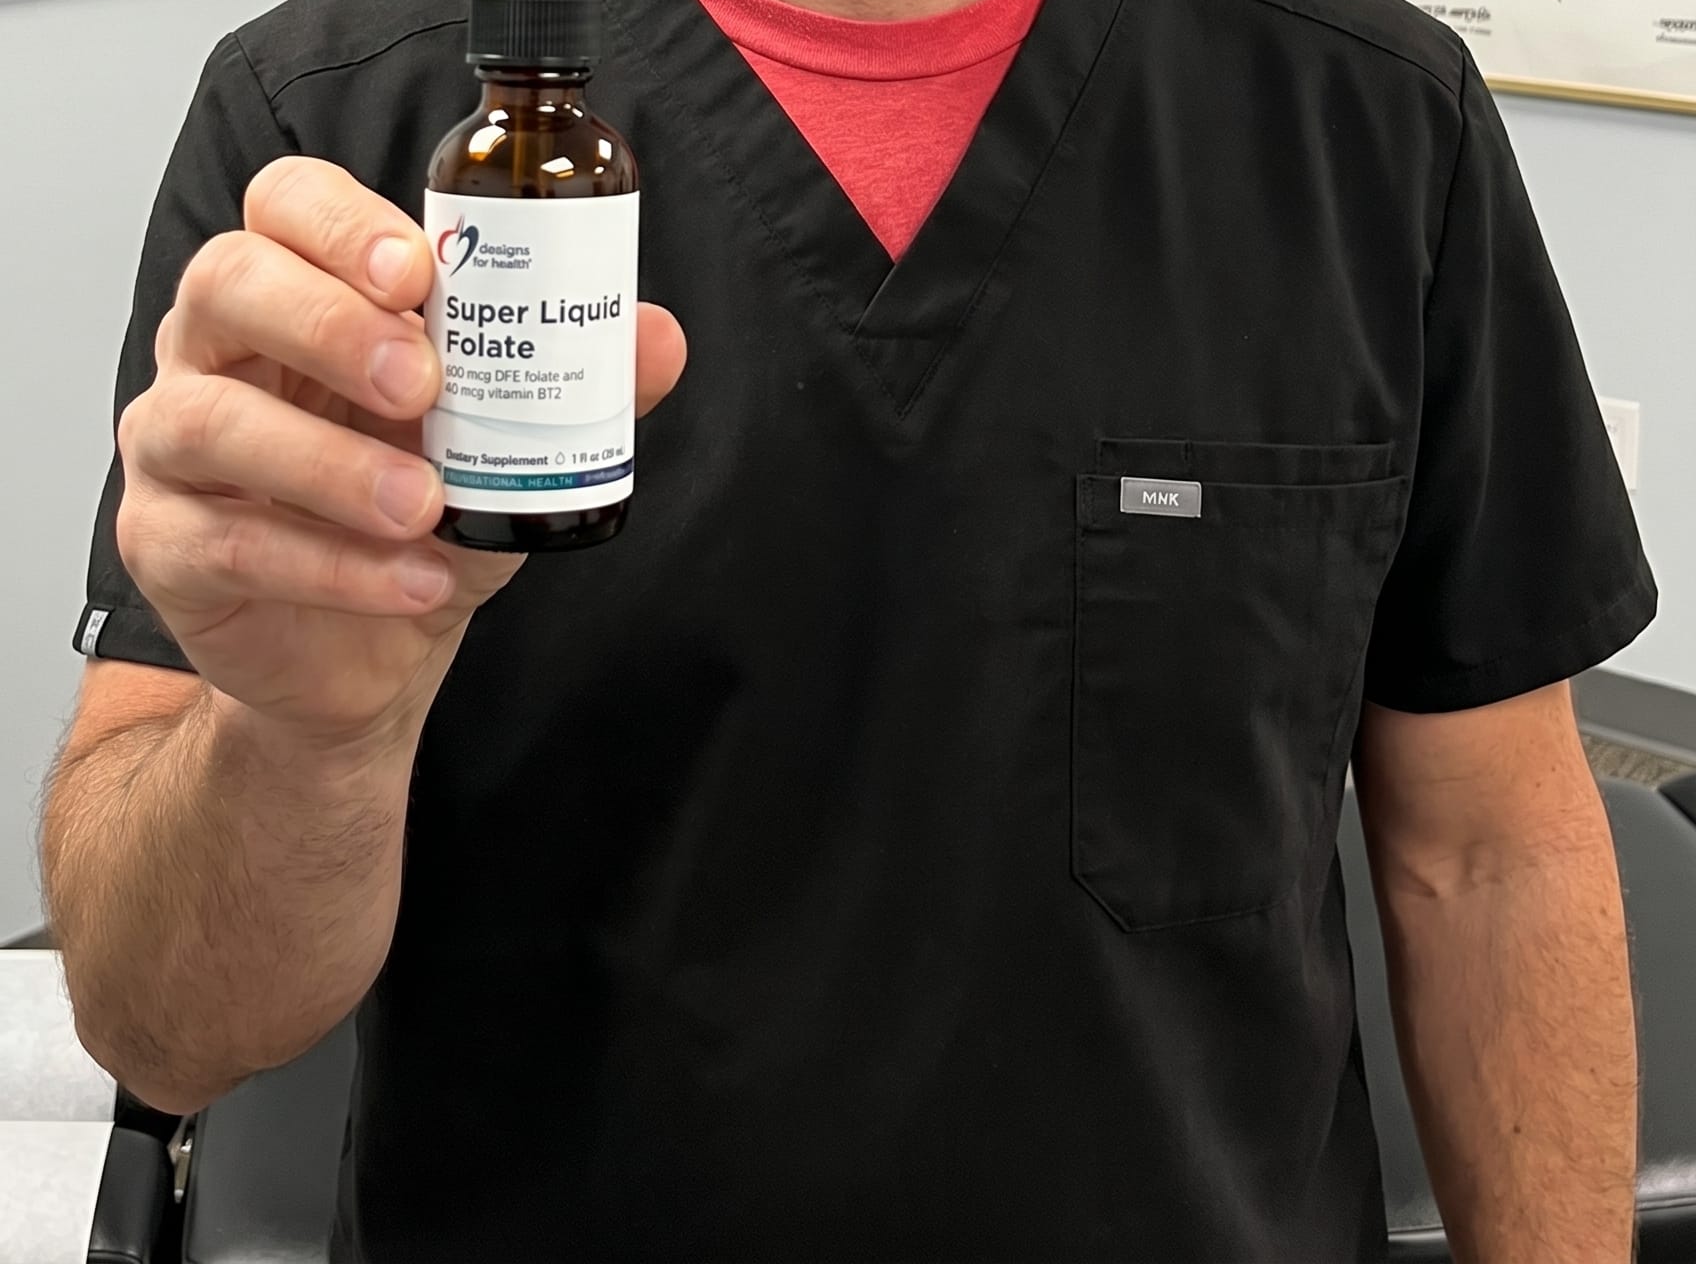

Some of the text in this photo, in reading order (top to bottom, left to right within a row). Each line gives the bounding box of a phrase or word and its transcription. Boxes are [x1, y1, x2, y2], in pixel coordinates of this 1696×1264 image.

[479, 243, 530, 259] designs
[473, 256, 488, 268] for
[446, 293, 621, 328] Super Liquid
[447, 329, 535, 359] Folate
[467, 369, 491, 384] mcg
[495, 369, 520, 382] DFE
[525, 369, 560, 383] folate
[562, 368, 584, 381] and
[461, 386, 484, 401] mcg
[488, 387, 533, 400] vitamin
[480, 453, 548, 468] Supplement
[528, 476, 573, 488] HEALTH
[1142, 491, 1179, 506] MNK
